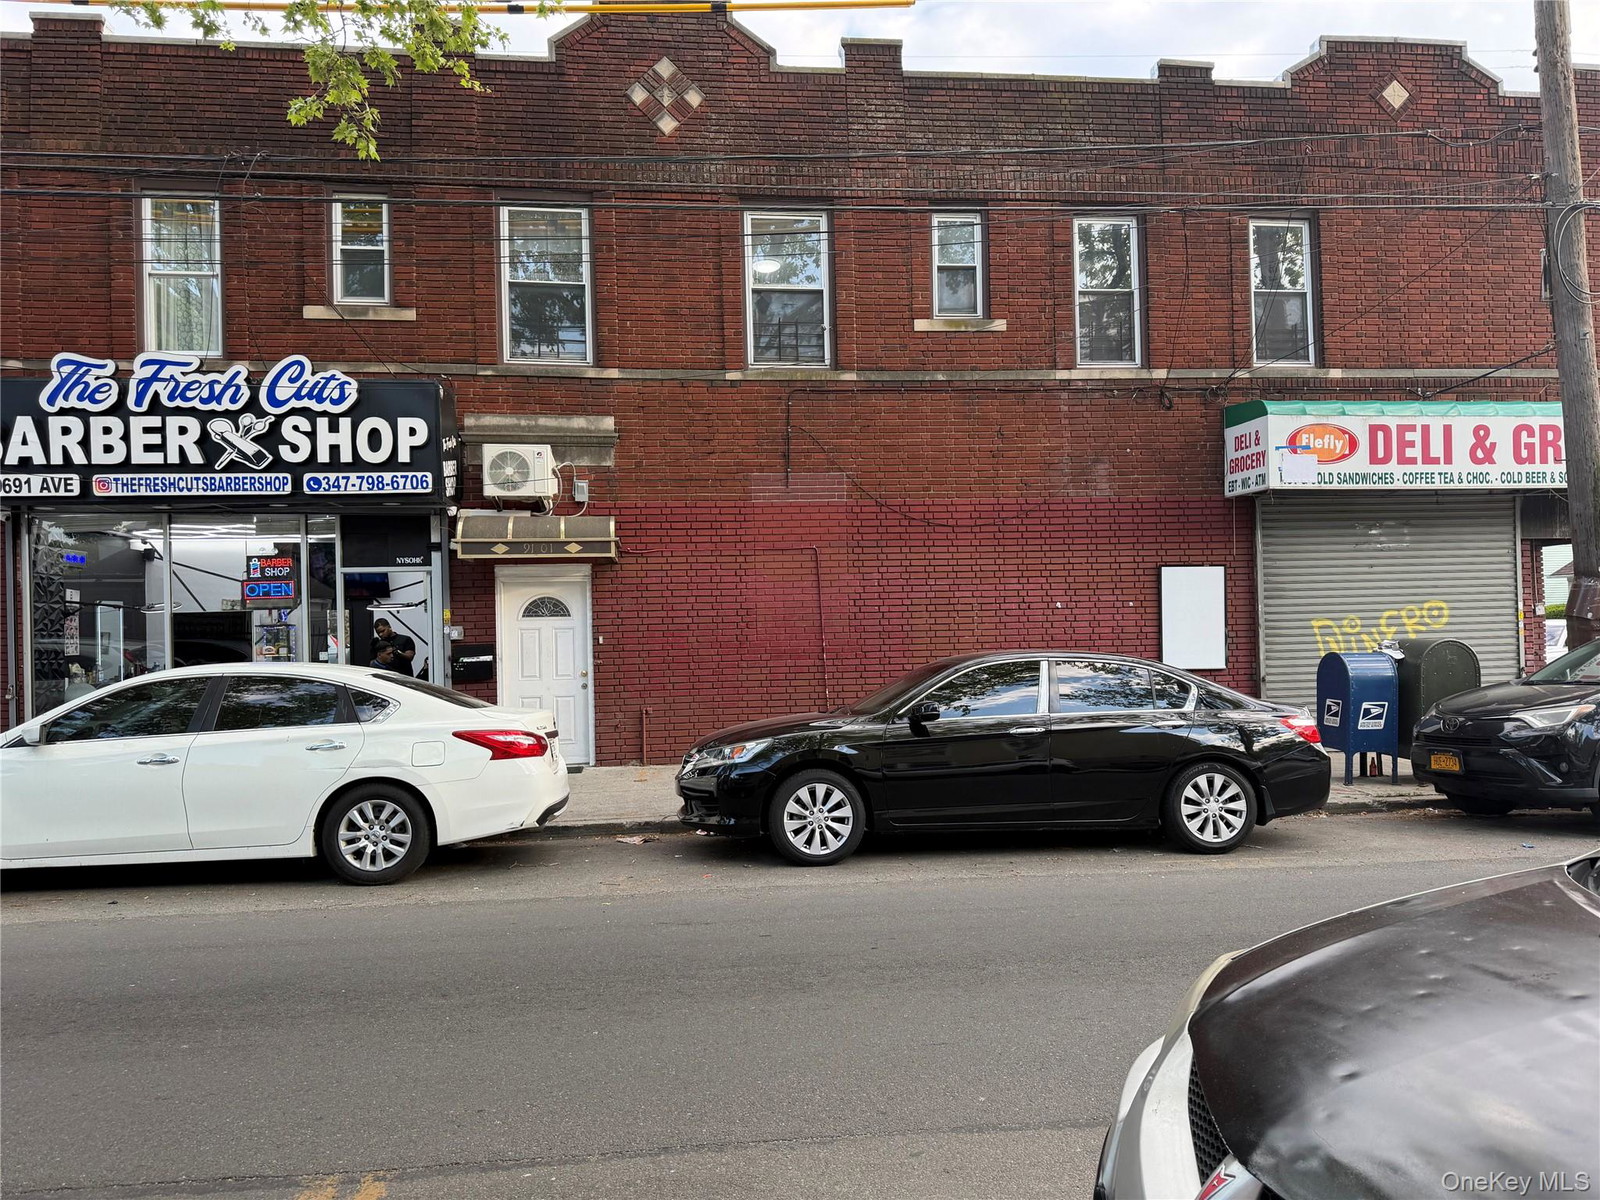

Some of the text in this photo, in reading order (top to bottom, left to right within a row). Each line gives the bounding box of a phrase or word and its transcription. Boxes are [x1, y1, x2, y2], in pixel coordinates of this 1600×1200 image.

[45, 357, 352, 409] The Fresh Cuts
[278, 415, 429, 464] SHOP
[1234, 430, 1261, 452] DELI &
[1369, 423, 1453, 466] DELI
[1469, 424, 1497, 466] &
[1229, 450, 1267, 475] GROCERY
[0, 476, 75, 494] 691 AVE
[112, 475, 290, 493] THEFRESHCUTSBARBERSHOP
[321, 474, 429, 492] 347-798-6706
[1228, 479, 1238, 493] EBT
[1241, 476, 1251, 490] WIC
[1255, 473, 1266, 487] ATM
[1312, 472, 1334, 485] OLD
[1336, 472, 1395, 485] SANDWICHES
[1402, 472, 1435, 484] COFFEE
[1437, 472, 1455, 484] TEA
[1457, 472, 1464, 484] &
[1466, 471, 1493, 484] CHOC.
[1500, 471, 1523, 484] COLD
[1525, 471, 1548, 484] BEER
[1550, 471, 1556, 484] &
[260, 557, 293, 568] BARBER
[264, 567, 290, 577] SHOP
[246, 583, 293, 597] OPEN
